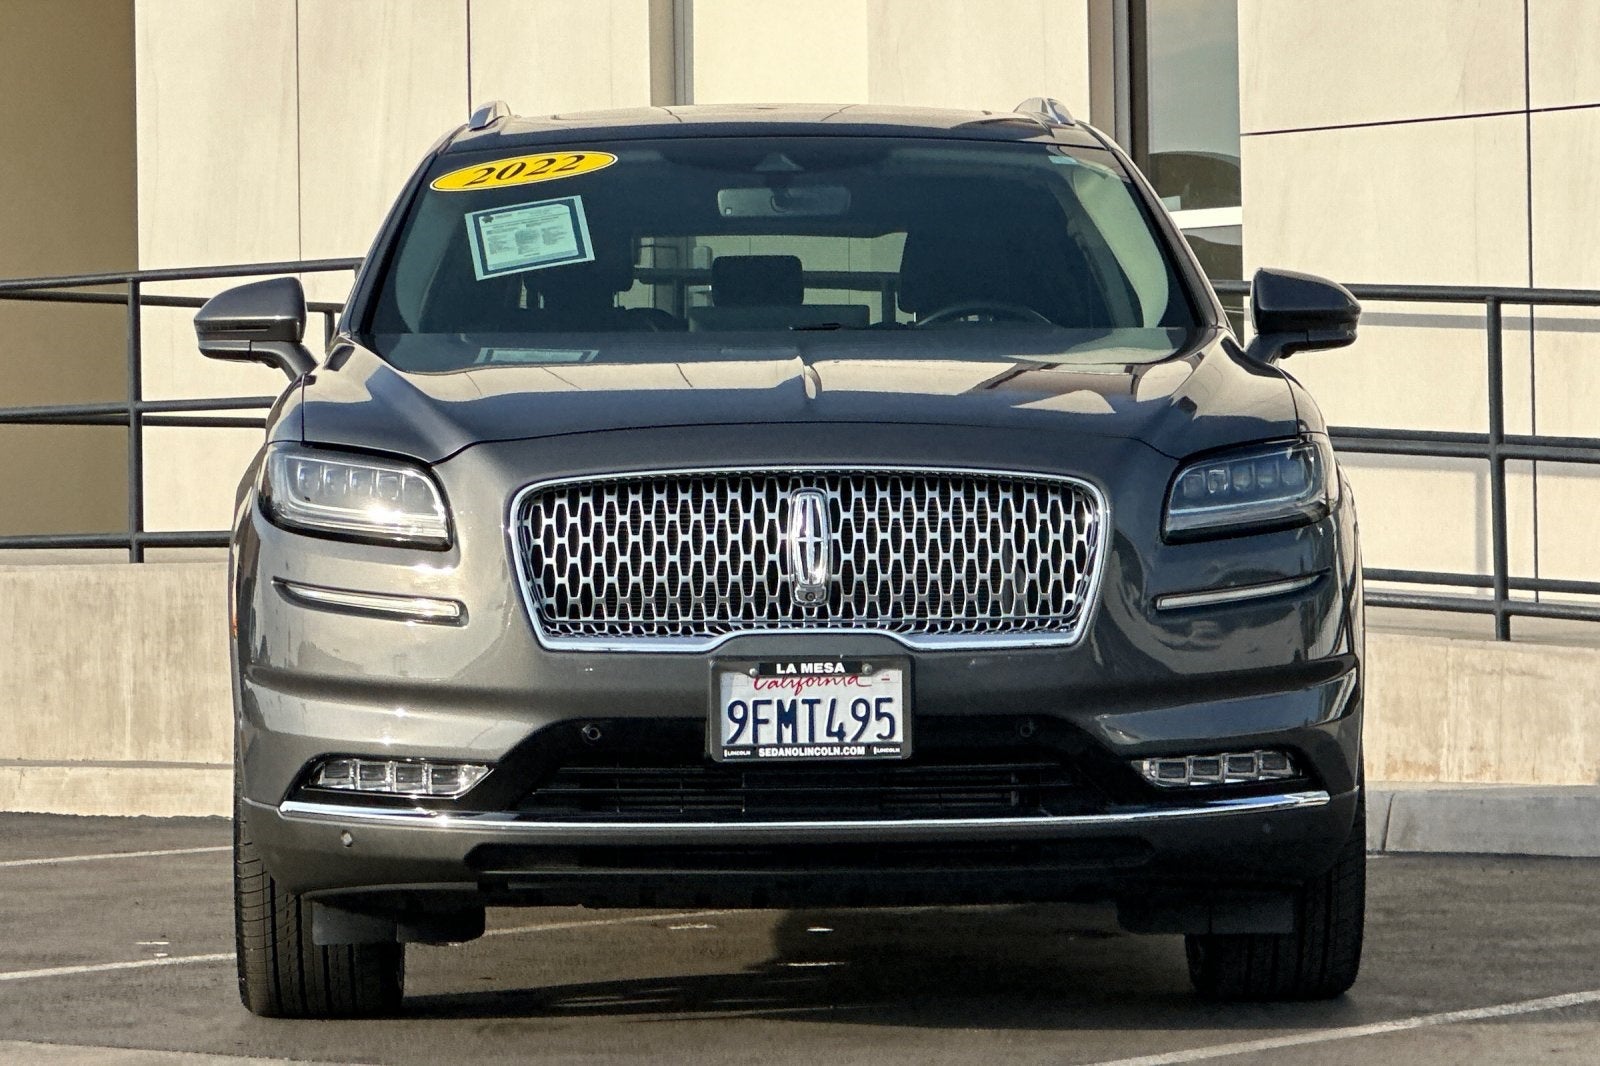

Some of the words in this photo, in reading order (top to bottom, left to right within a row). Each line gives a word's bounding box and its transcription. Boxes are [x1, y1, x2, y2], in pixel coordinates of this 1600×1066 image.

[463, 154, 586, 187] 2022
[776, 663, 797, 674] LA
[800, 662, 845, 674] MESA
[726, 697, 896, 744] 9FMT495
[758, 746, 866, 757] SEDANOLINCOLN.COM
